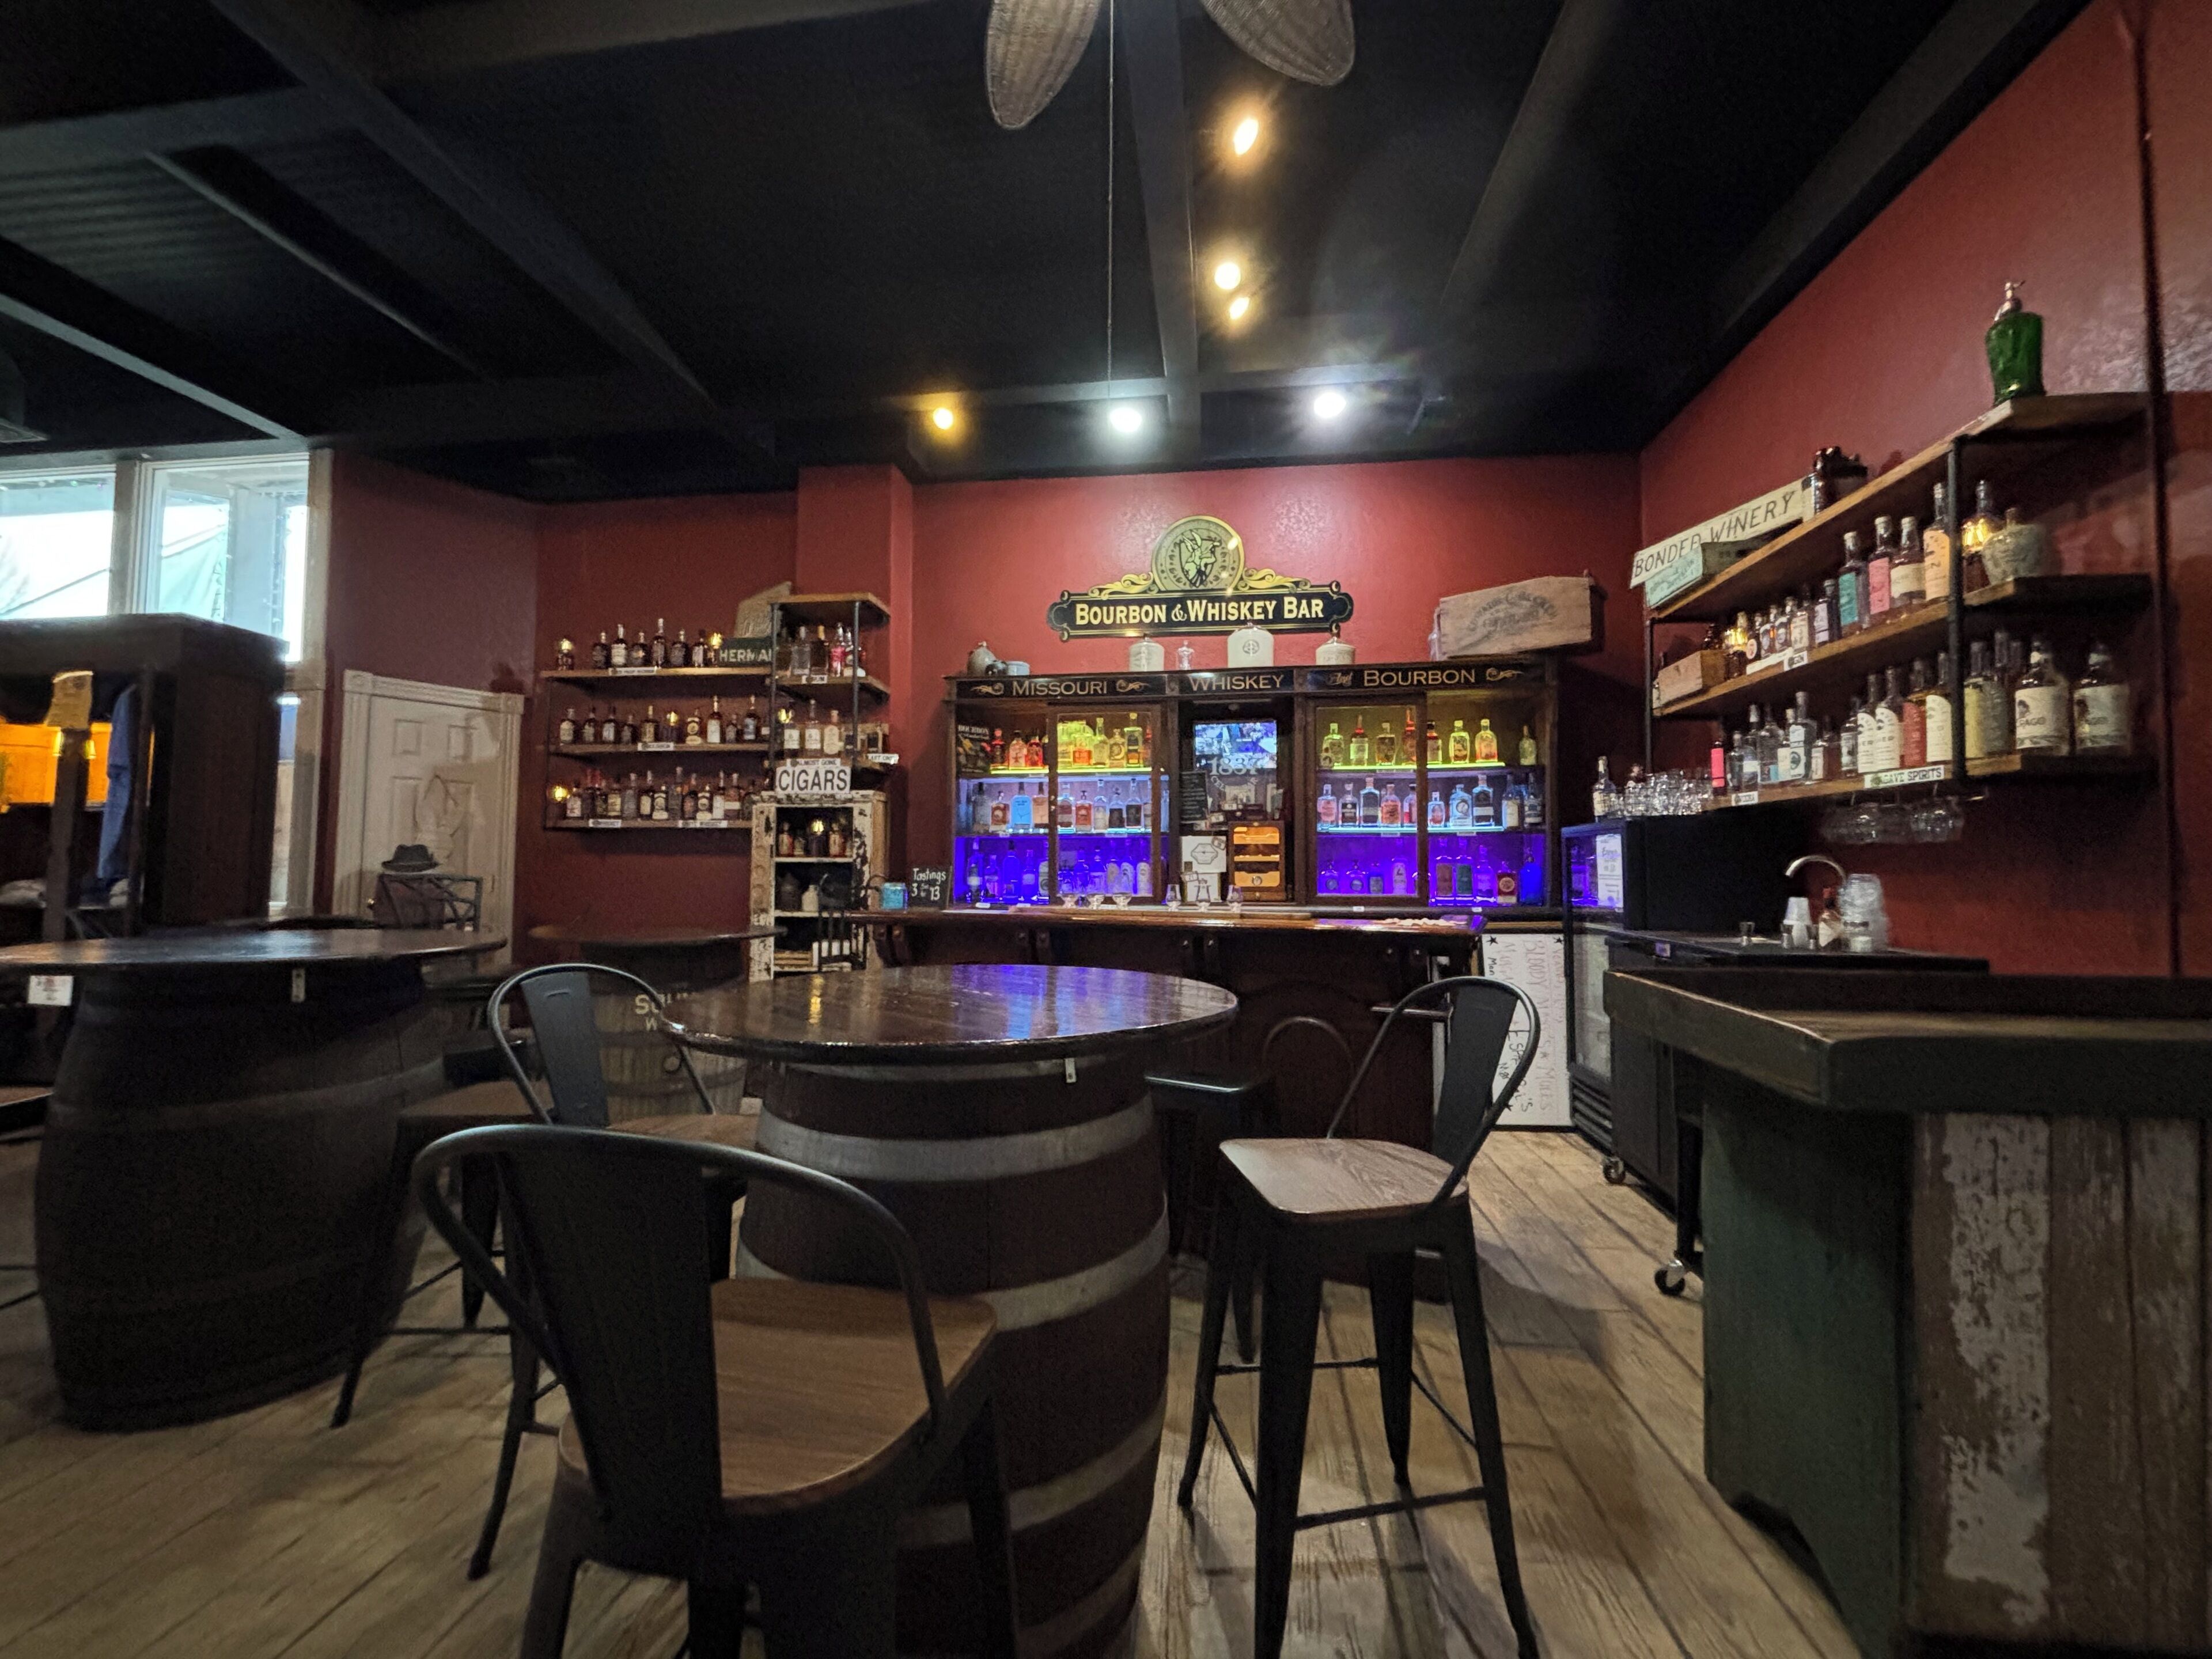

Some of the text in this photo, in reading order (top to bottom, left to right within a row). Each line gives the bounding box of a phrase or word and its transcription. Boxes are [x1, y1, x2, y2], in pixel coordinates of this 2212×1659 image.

[1710, 491, 1795, 543] WINERY
[1075, 596, 1324, 625] BOURBON & WHISKEY BAR
[1190, 675, 1284, 692] WHISKEY
[1364, 669, 1475, 687] BOURBON
[1012, 680, 1108, 696] MISSOURI
[778, 770, 847, 791] CIGARS
[913, 868, 946, 885] Tastings
[1525, 940, 1546, 987] BLOODY
